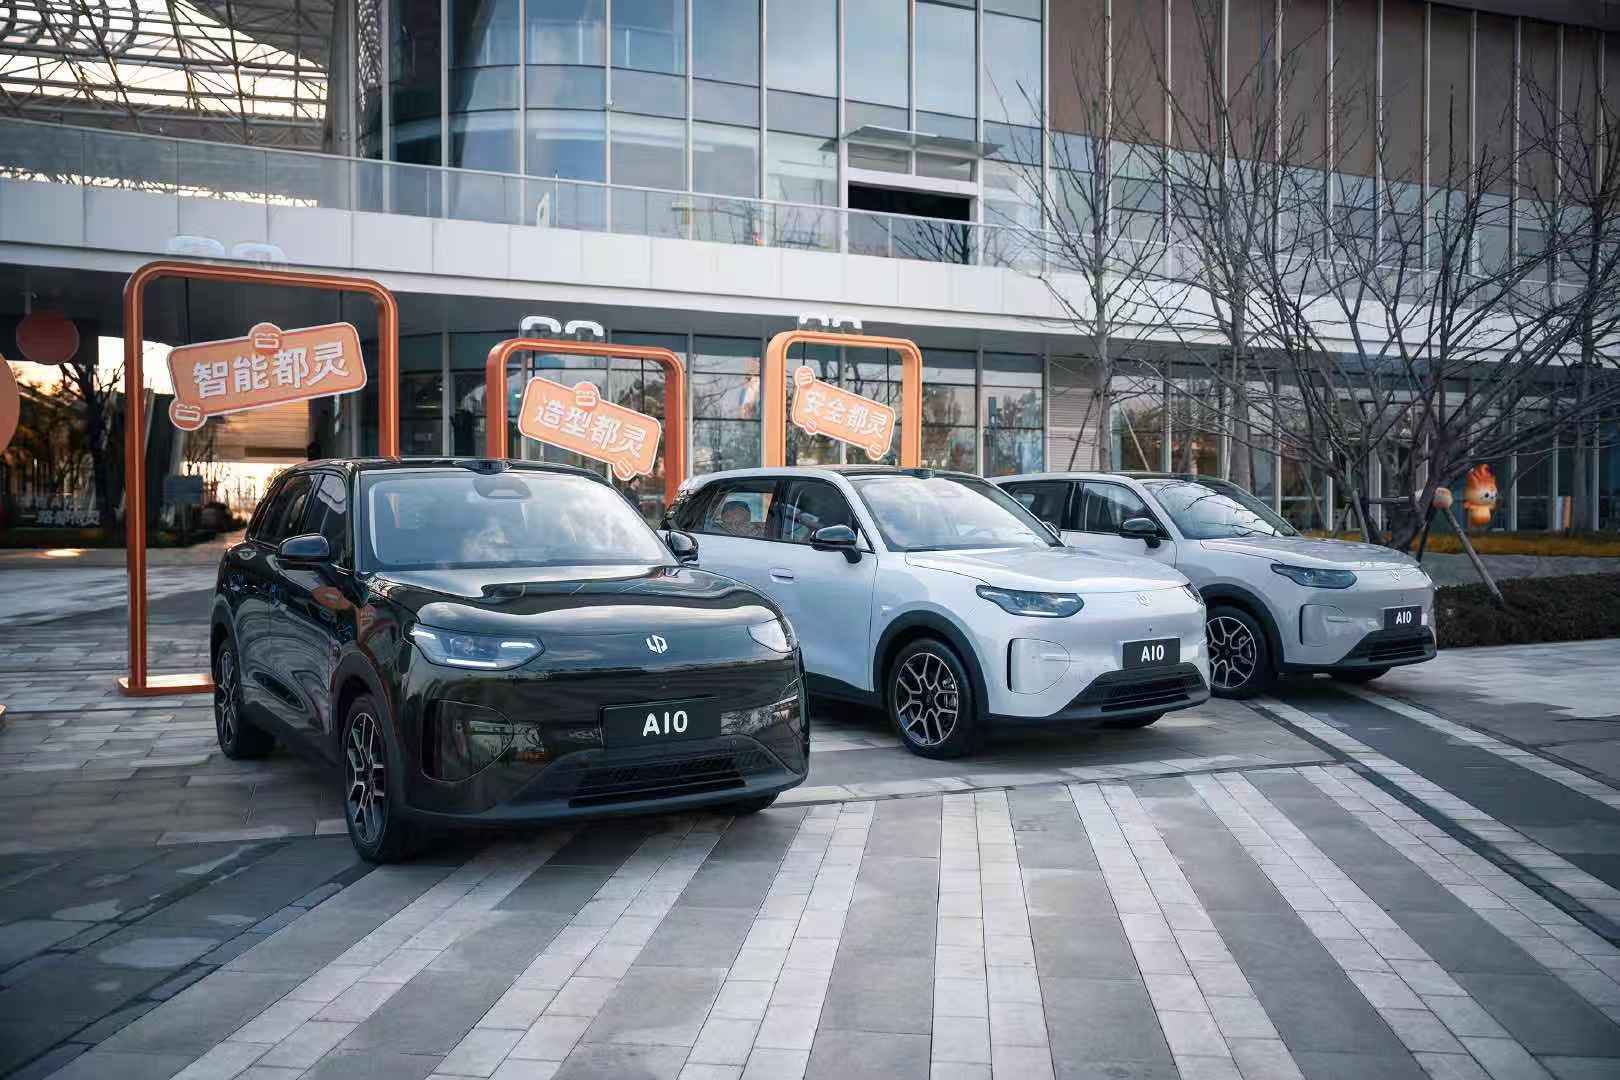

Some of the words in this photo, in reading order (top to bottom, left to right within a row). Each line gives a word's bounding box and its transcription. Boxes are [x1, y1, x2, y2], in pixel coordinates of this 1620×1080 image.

[192, 340, 351, 399] 智能都灵
[534, 398, 647, 458] 造型都灵
[804, 389, 887, 439] 安全都灵
